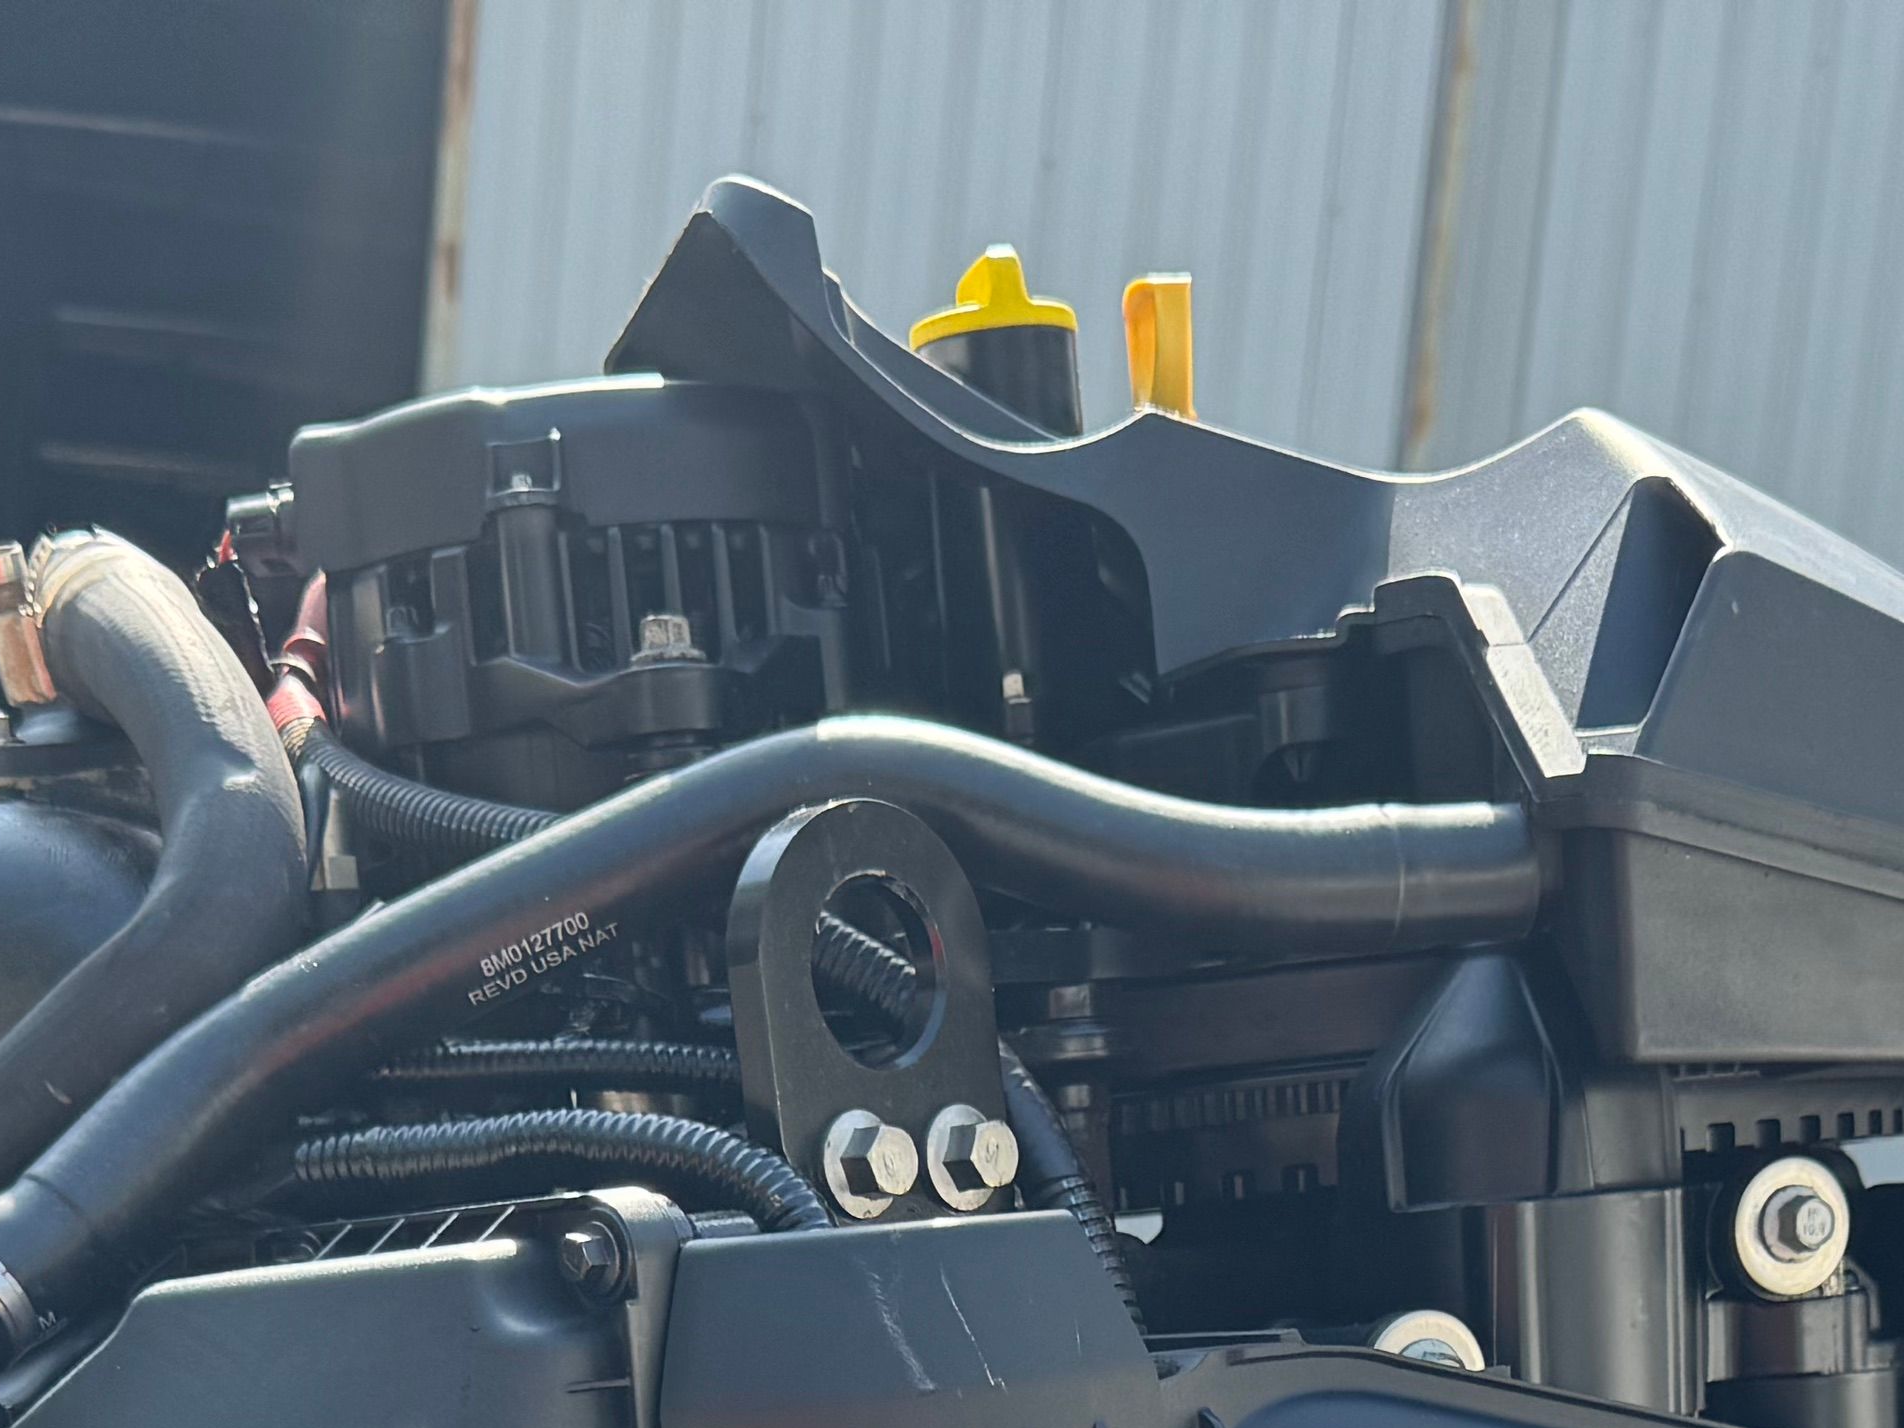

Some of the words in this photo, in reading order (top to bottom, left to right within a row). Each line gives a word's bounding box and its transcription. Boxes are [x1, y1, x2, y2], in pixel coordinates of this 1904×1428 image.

[467, 968, 528, 1007] REVD
[530, 946, 578, 974] USA
[578, 921, 619, 953] NAT
[480, 911, 590, 978] 8M0127700
